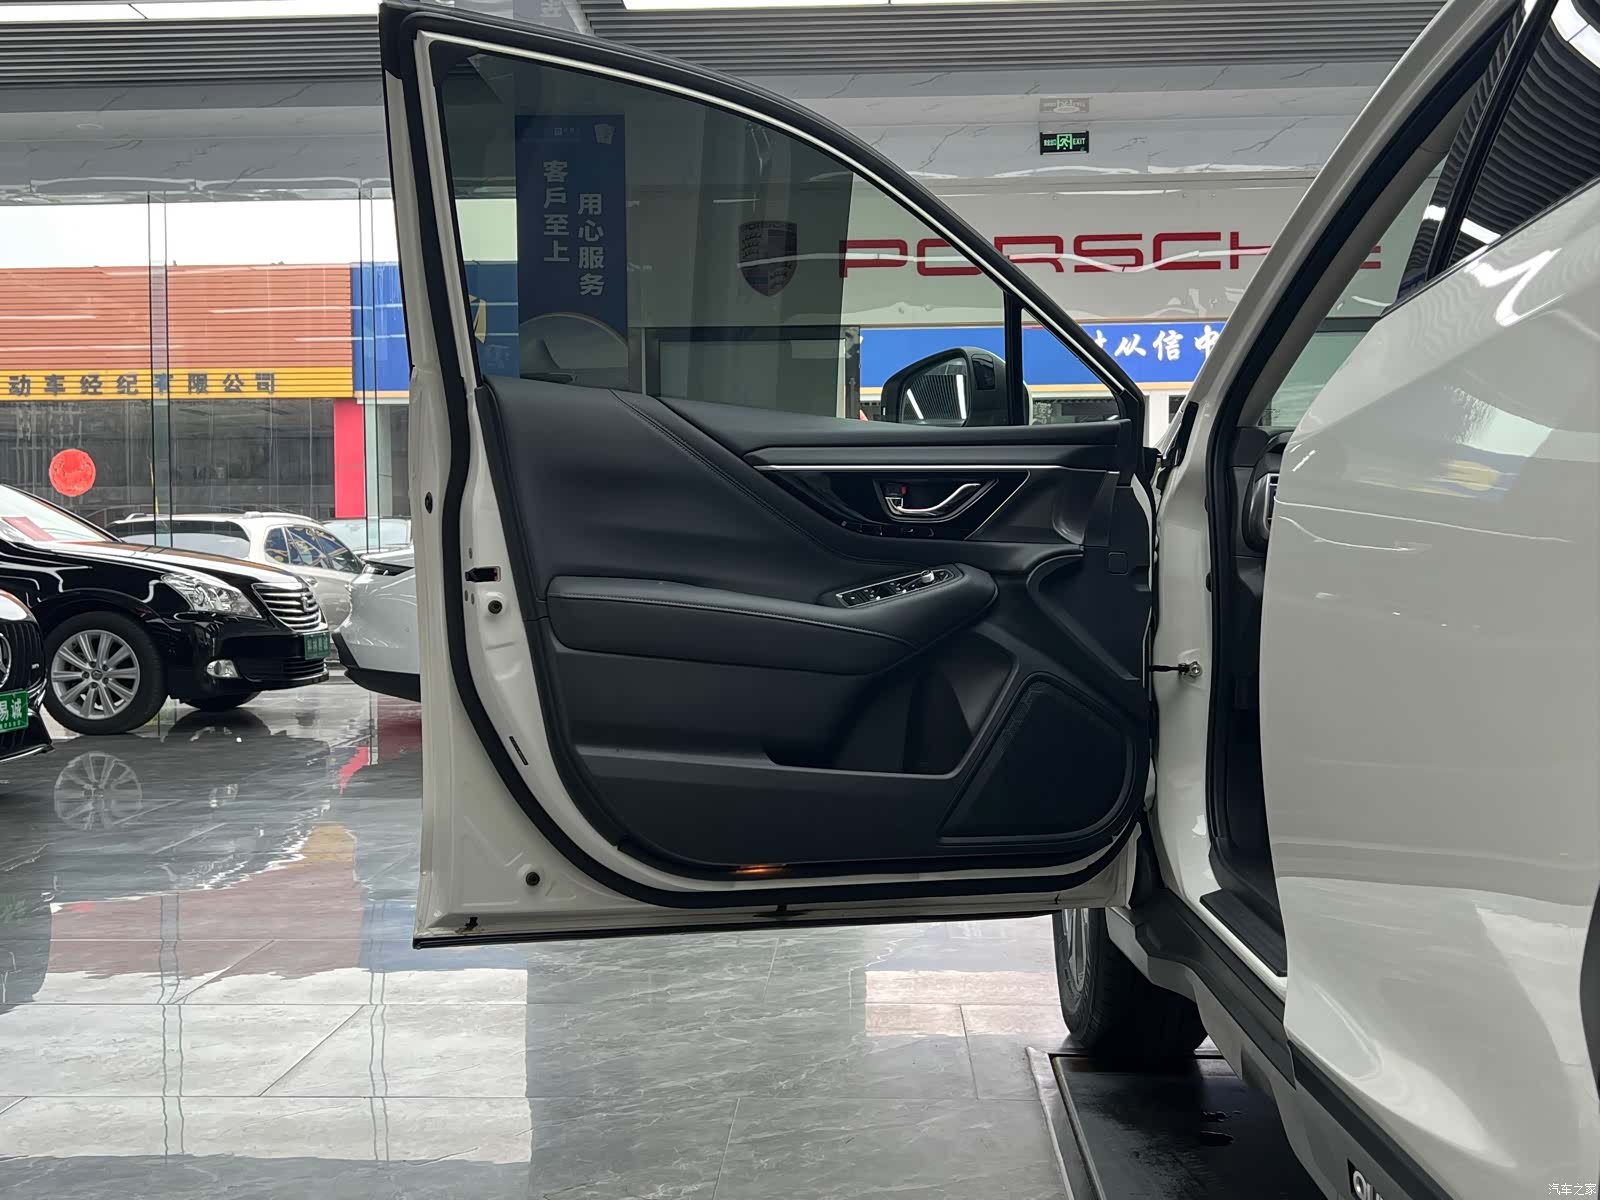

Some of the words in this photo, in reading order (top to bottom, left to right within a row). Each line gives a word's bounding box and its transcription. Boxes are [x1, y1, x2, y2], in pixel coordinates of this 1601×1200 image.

[578, 193, 604, 296] 用心服务
[839, 231, 1381, 277] PORSCH
[1094, 325, 1219, 360] 从信中
